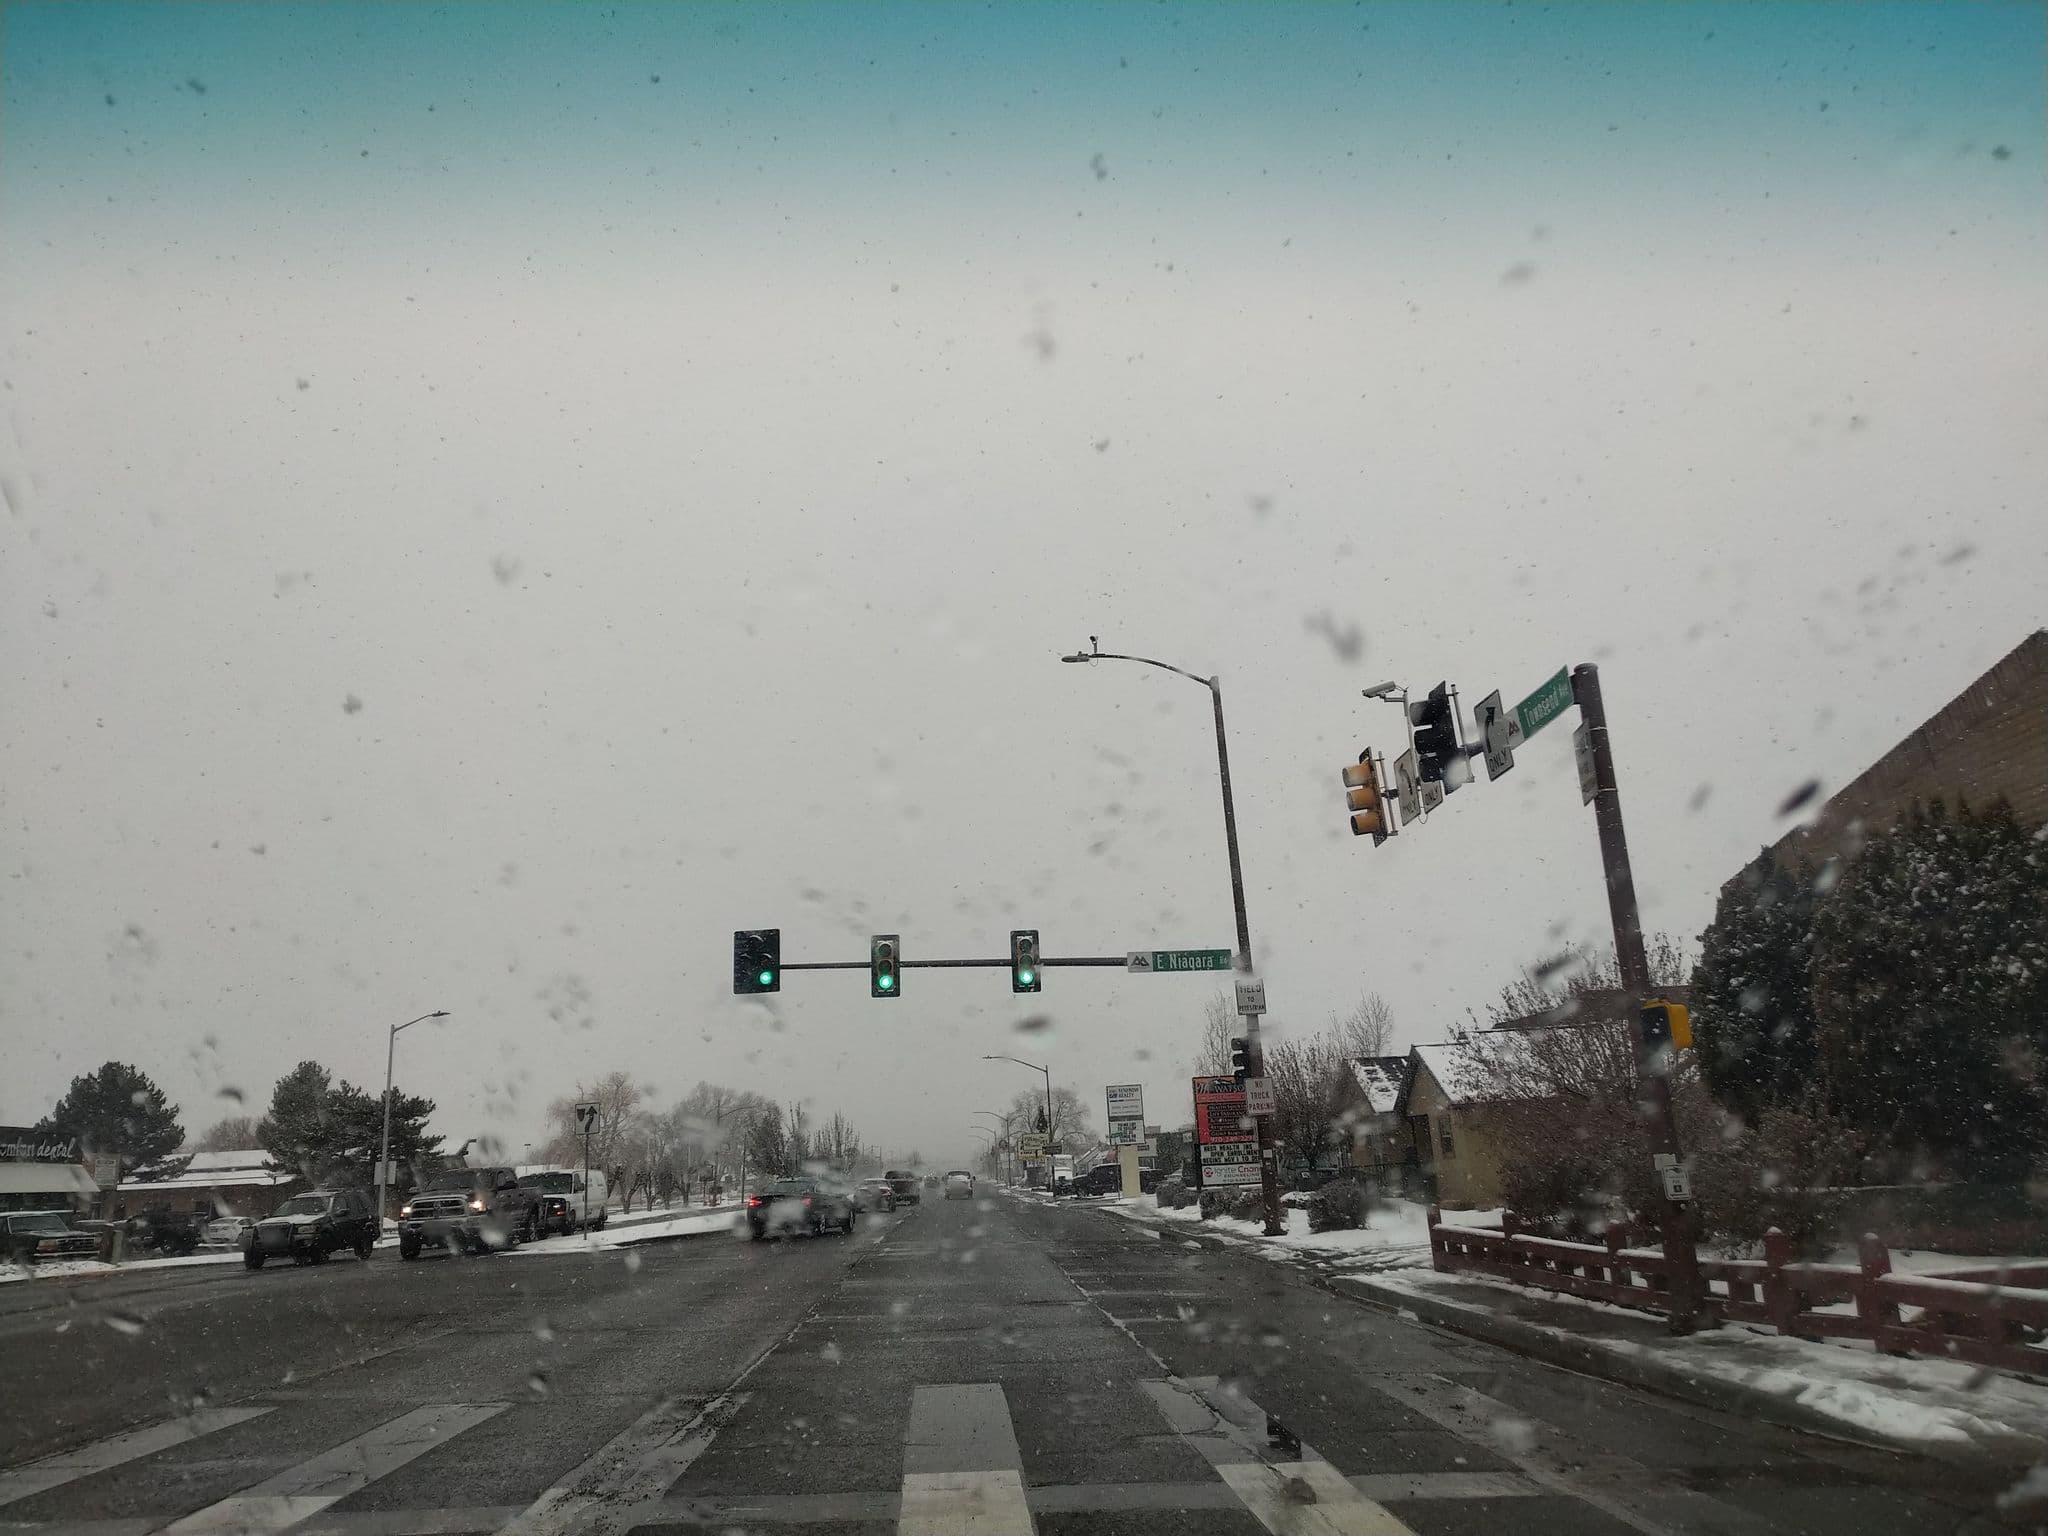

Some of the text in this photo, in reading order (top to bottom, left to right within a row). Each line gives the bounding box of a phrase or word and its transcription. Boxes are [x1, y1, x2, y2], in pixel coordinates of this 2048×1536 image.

[1489, 751, 1508, 772] ONLY
[1424, 785, 1439, 806] ONLY
[1157, 954, 1164, 968] E
[1169, 954, 1213, 970] Niagara
[1239, 985, 1262, 993] YIELD
[1250, 1091, 1270, 1099] TRUCK
[1249, 1102, 1274, 1110] PARKING
[37, 1137, 76, 1158] dental
